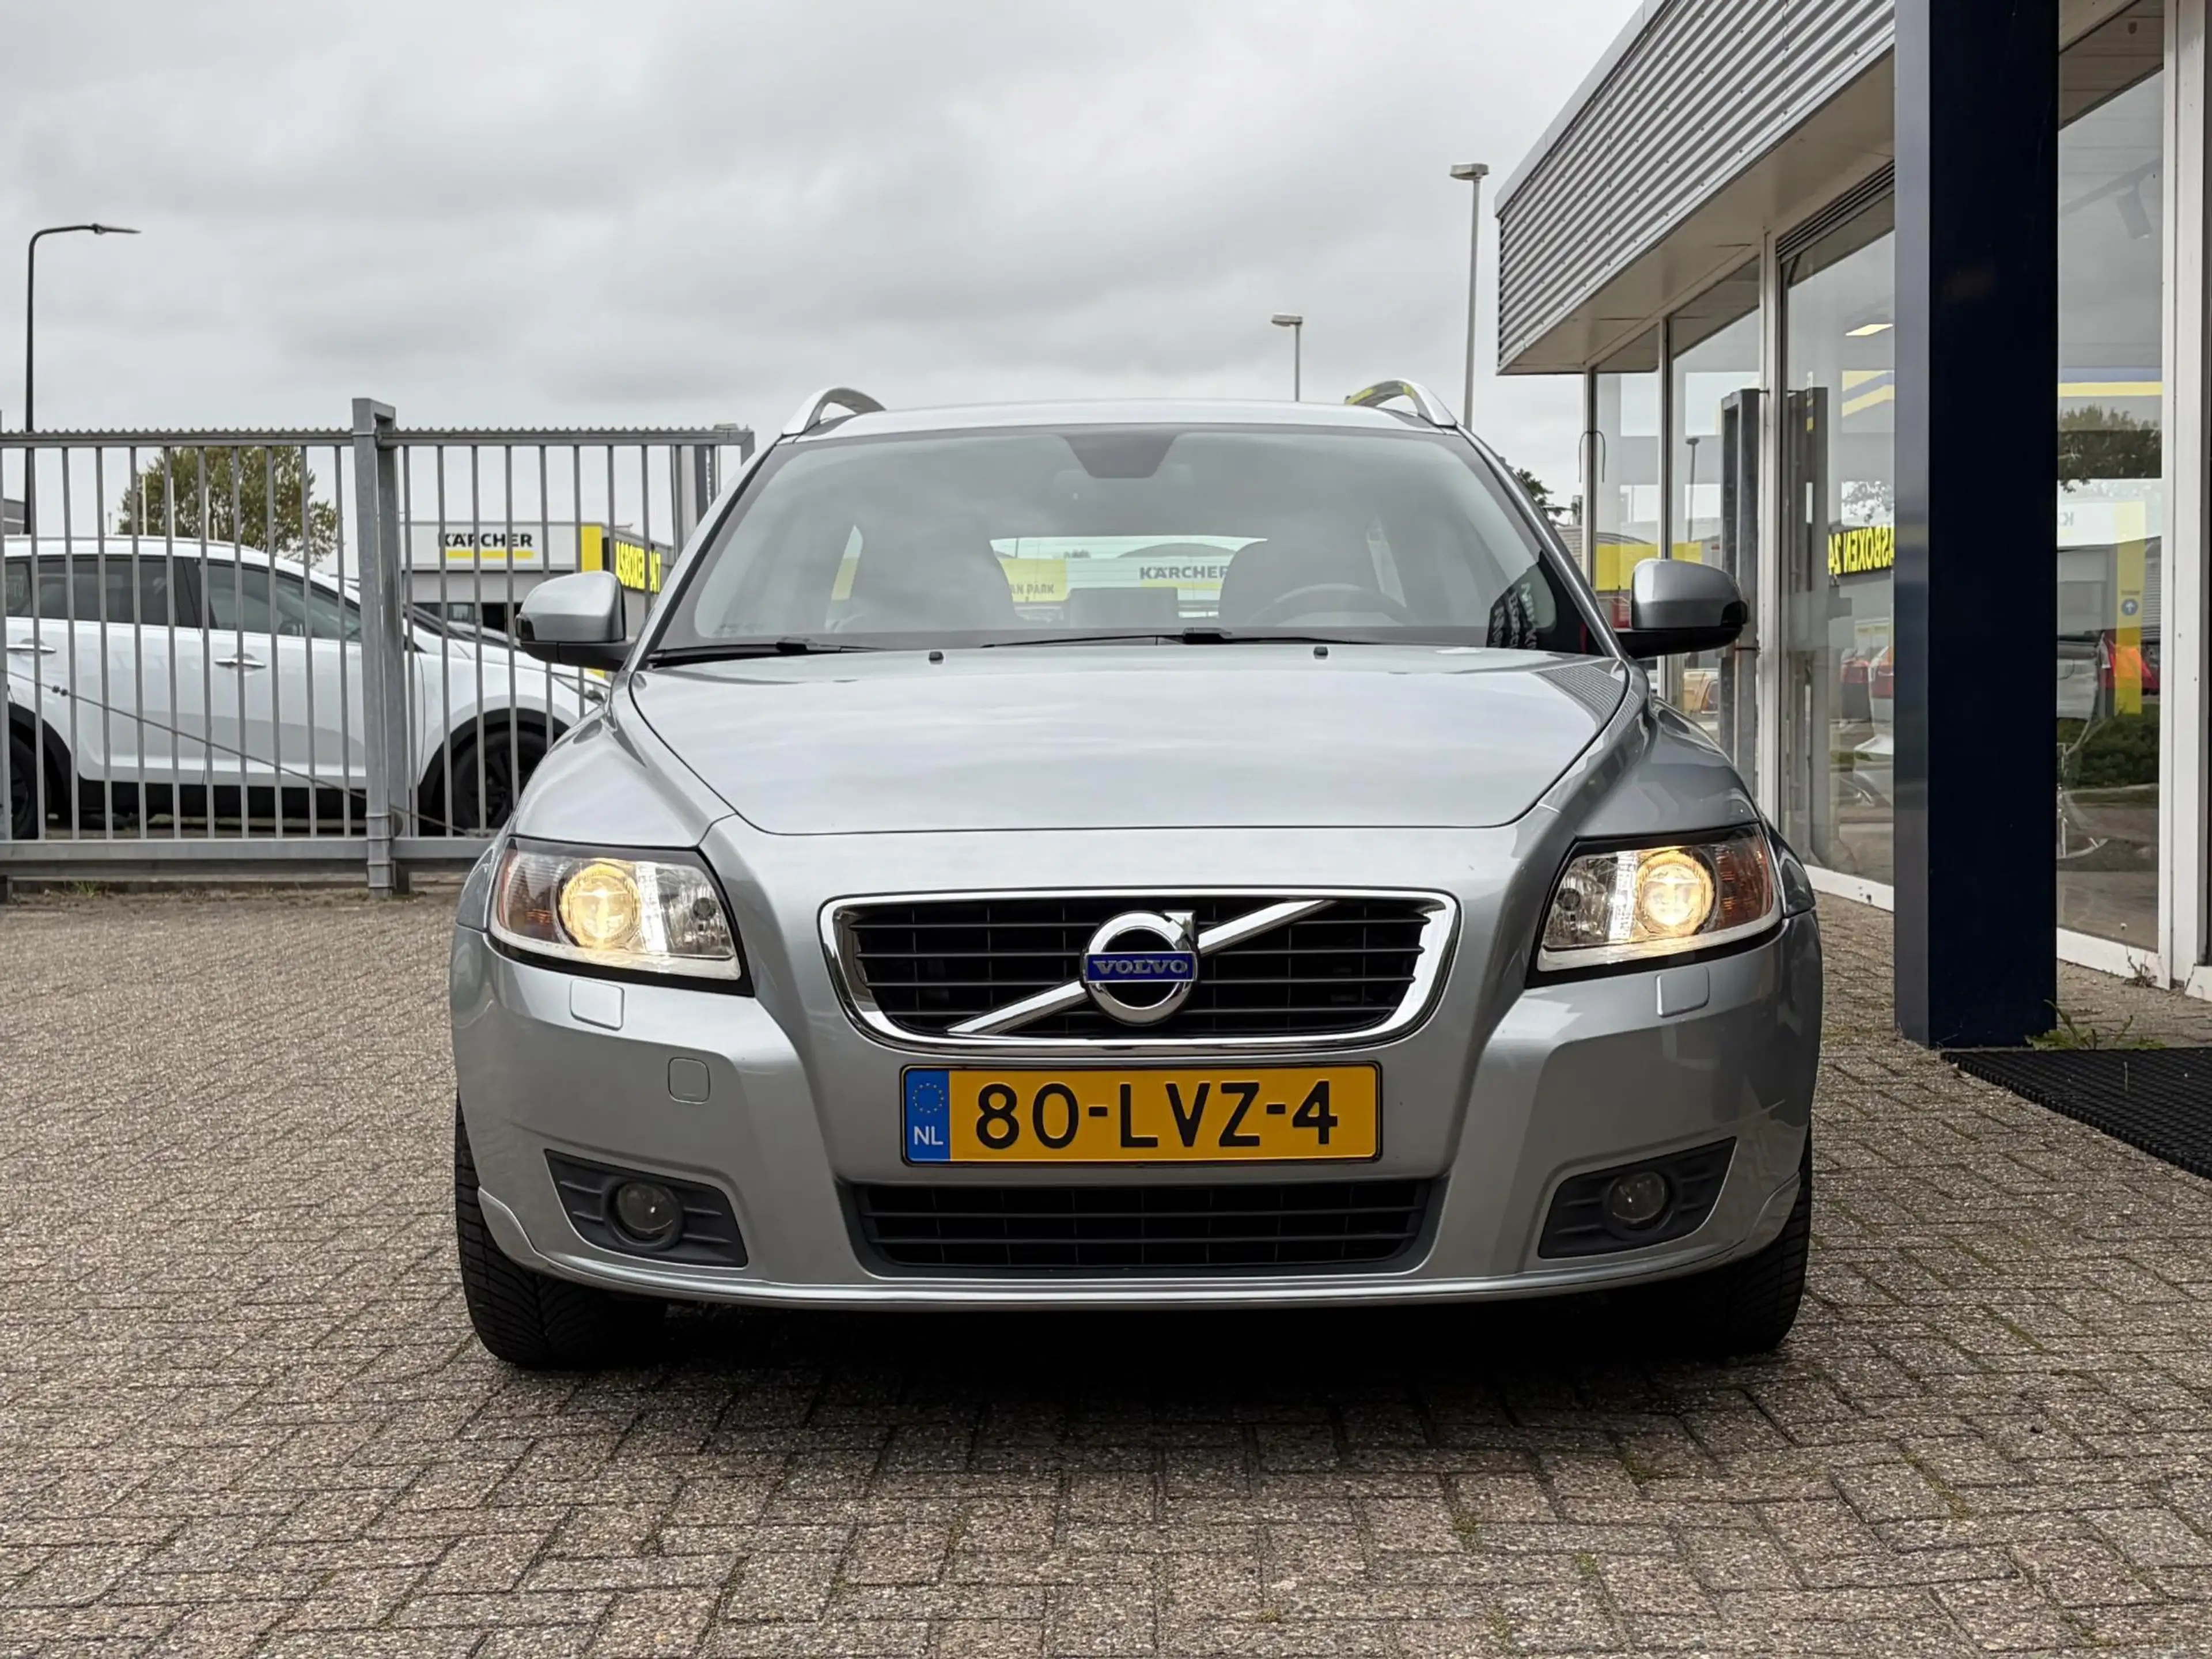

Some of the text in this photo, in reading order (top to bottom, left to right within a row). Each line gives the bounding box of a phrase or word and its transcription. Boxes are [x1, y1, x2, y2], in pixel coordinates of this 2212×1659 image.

[1093, 959, 1188, 975] VOLVO
[976, 1081, 1338, 1150] 80-LVZ-4
[914, 1126, 944, 1145] NL
